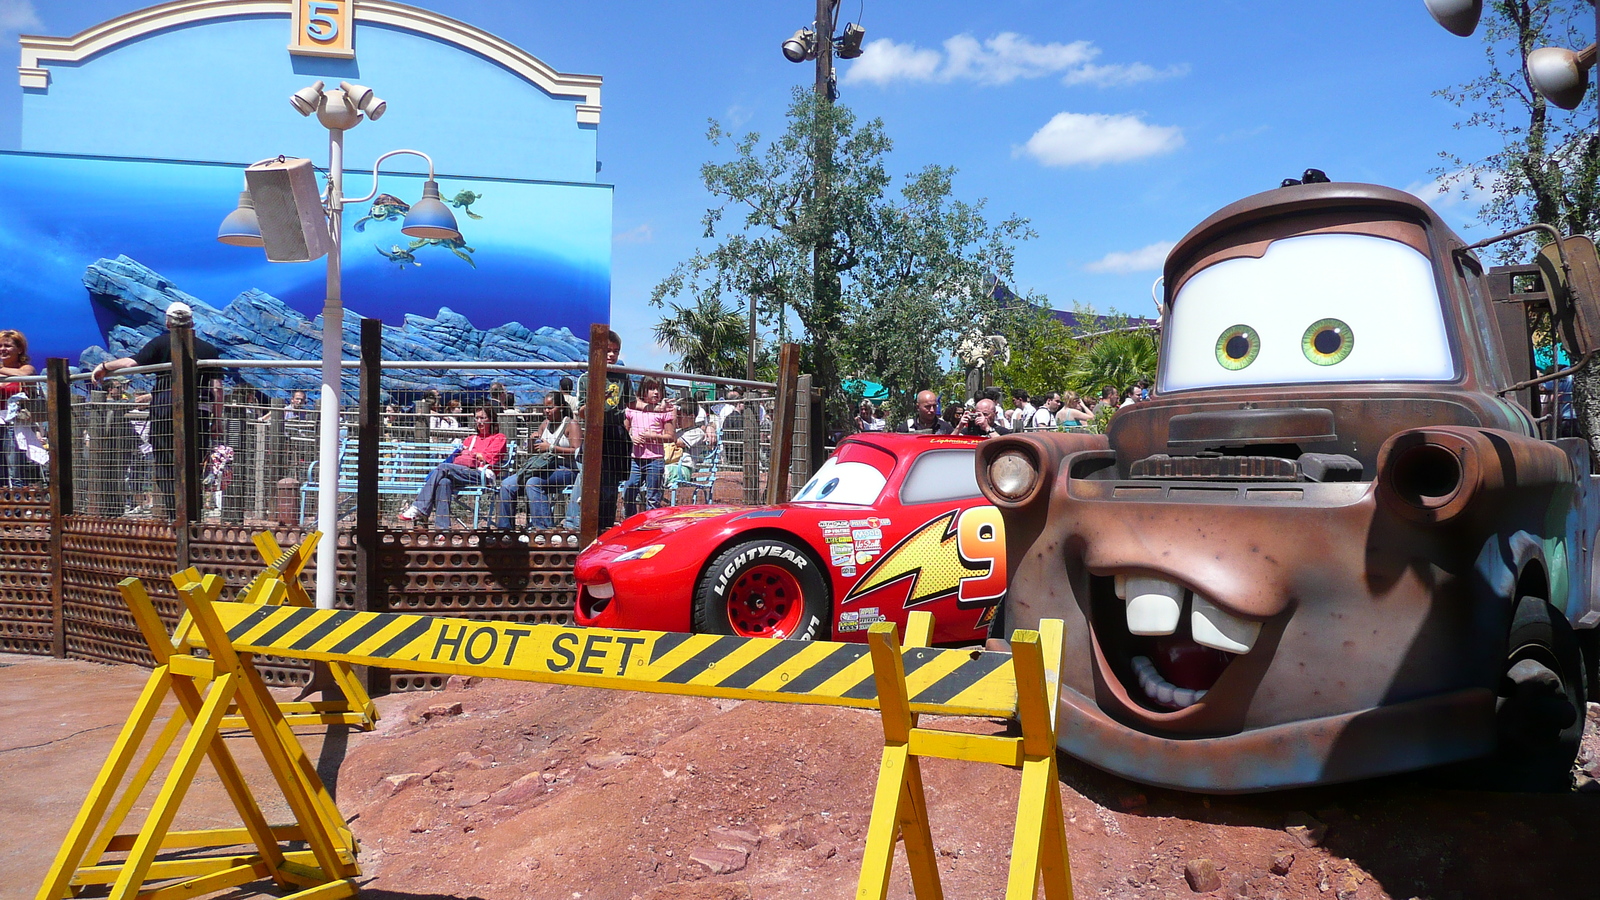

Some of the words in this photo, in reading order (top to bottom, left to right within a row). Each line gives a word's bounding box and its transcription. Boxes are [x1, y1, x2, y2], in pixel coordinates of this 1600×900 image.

[306, 2, 339, 42] 5
[854, 529, 880, 539] MOOD
[957, 505, 1007, 603] 9
[713, 545, 808, 597] LIGHTYEAR
[431, 624, 532, 666] HOT
[546, 633, 645, 676] SET
